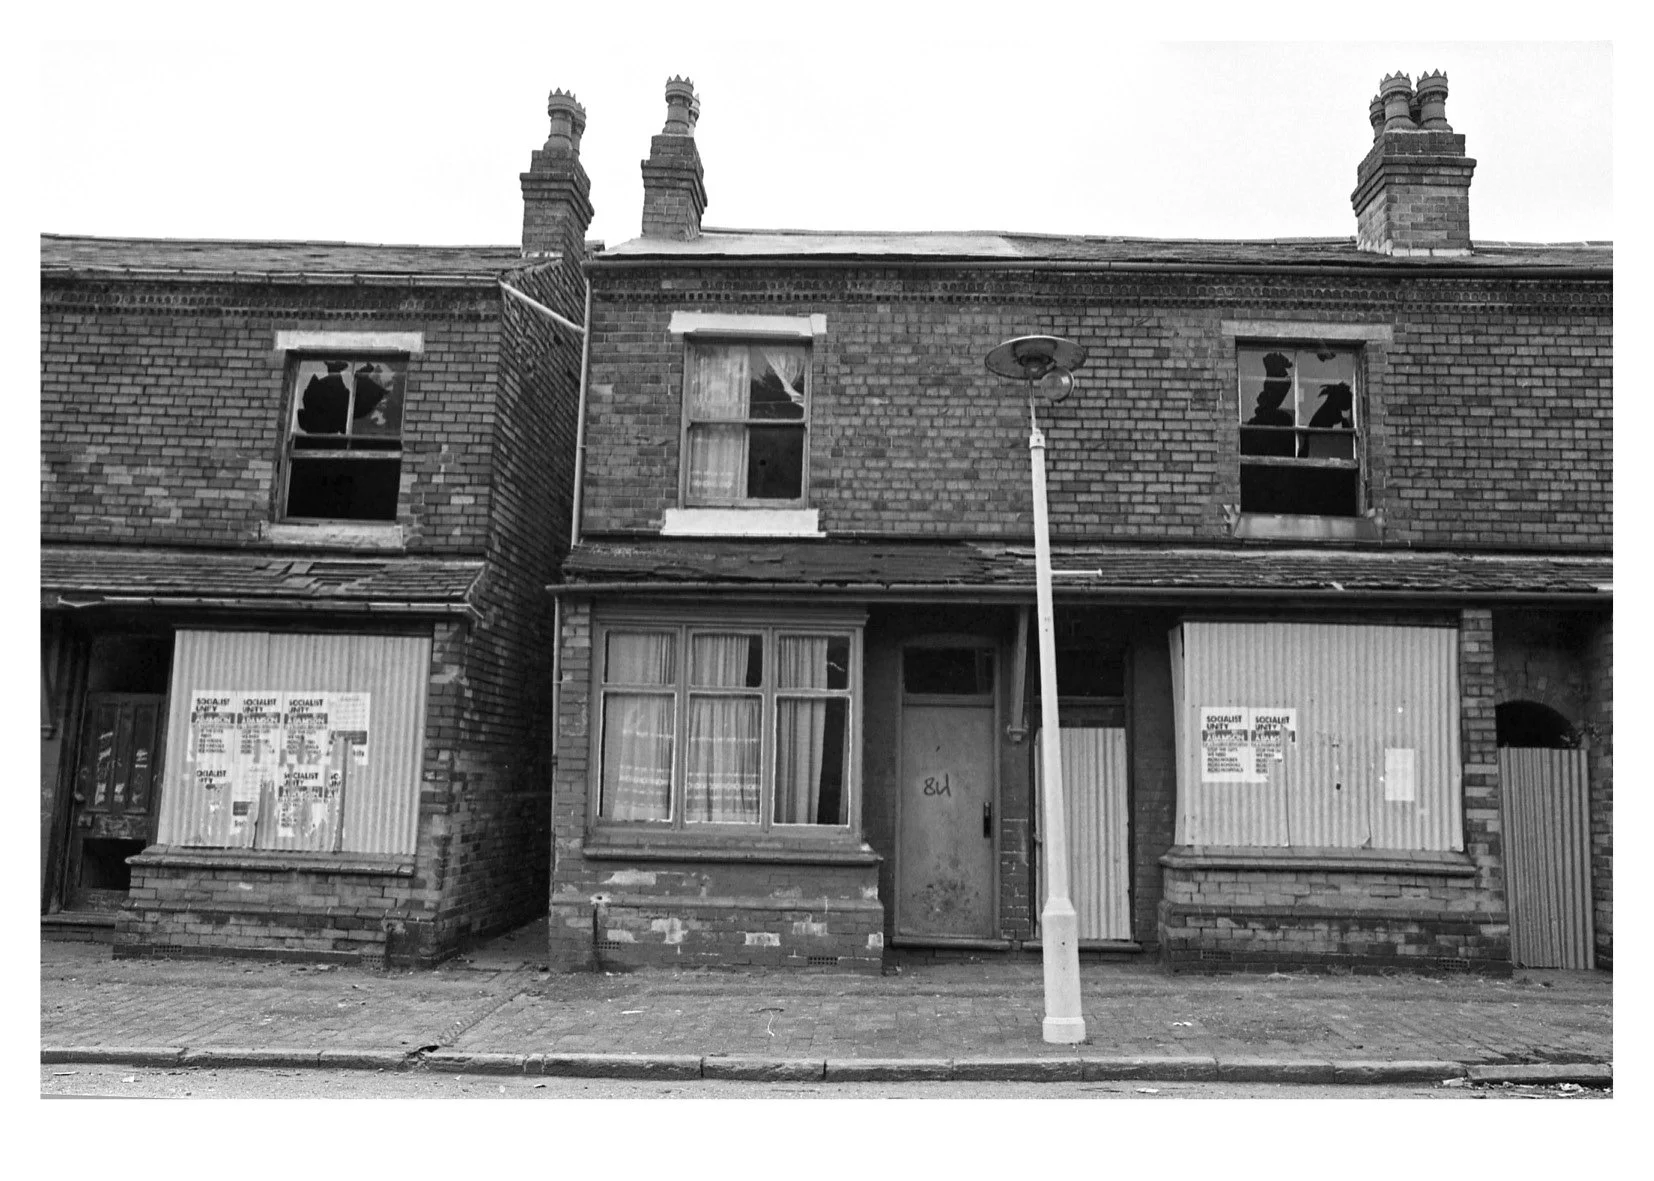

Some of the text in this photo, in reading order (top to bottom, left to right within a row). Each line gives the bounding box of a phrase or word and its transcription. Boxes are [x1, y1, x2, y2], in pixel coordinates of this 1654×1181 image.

[196, 698, 230, 706] SOCIALIST
[243, 698, 277, 706] SOCIALIST
[289, 699, 323, 707] SOCIALIST
[195, 705, 218, 713] UNITY
[1206, 715, 1242, 723] SOCIALIST
[1255, 716, 1290, 724] SOCIALIST
[1255, 723, 1277, 731] UNITY
